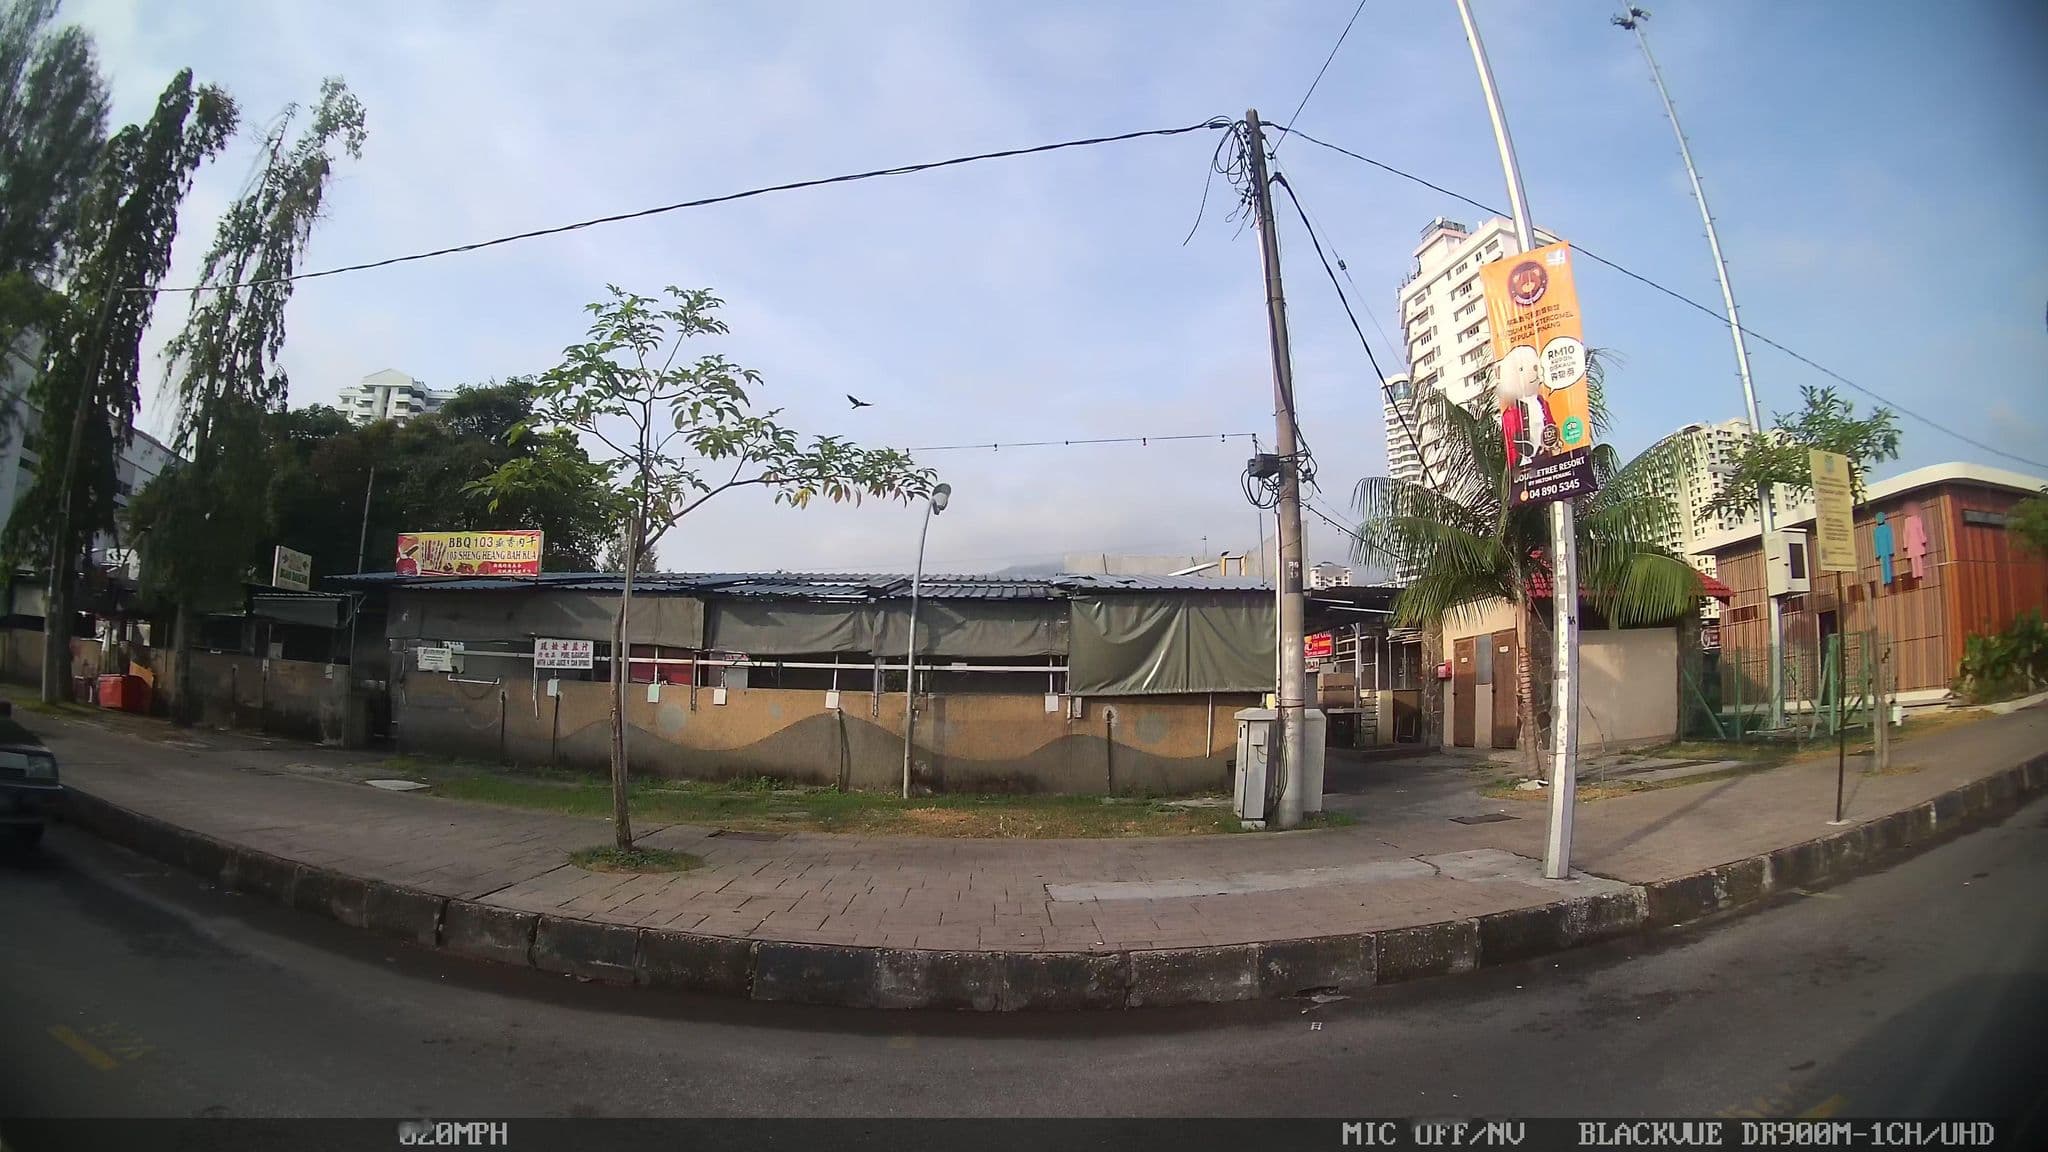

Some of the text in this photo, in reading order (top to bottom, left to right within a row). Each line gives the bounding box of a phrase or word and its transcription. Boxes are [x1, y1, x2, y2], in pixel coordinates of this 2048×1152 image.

[1547, 345, 1575, 361] RM10
[1559, 456, 1585, 471] RESORT
[1529, 478, 1580, 499] 04 890 5345
[448, 536, 494, 548] BBQ 103
[458, 550, 481, 561] SHENG
